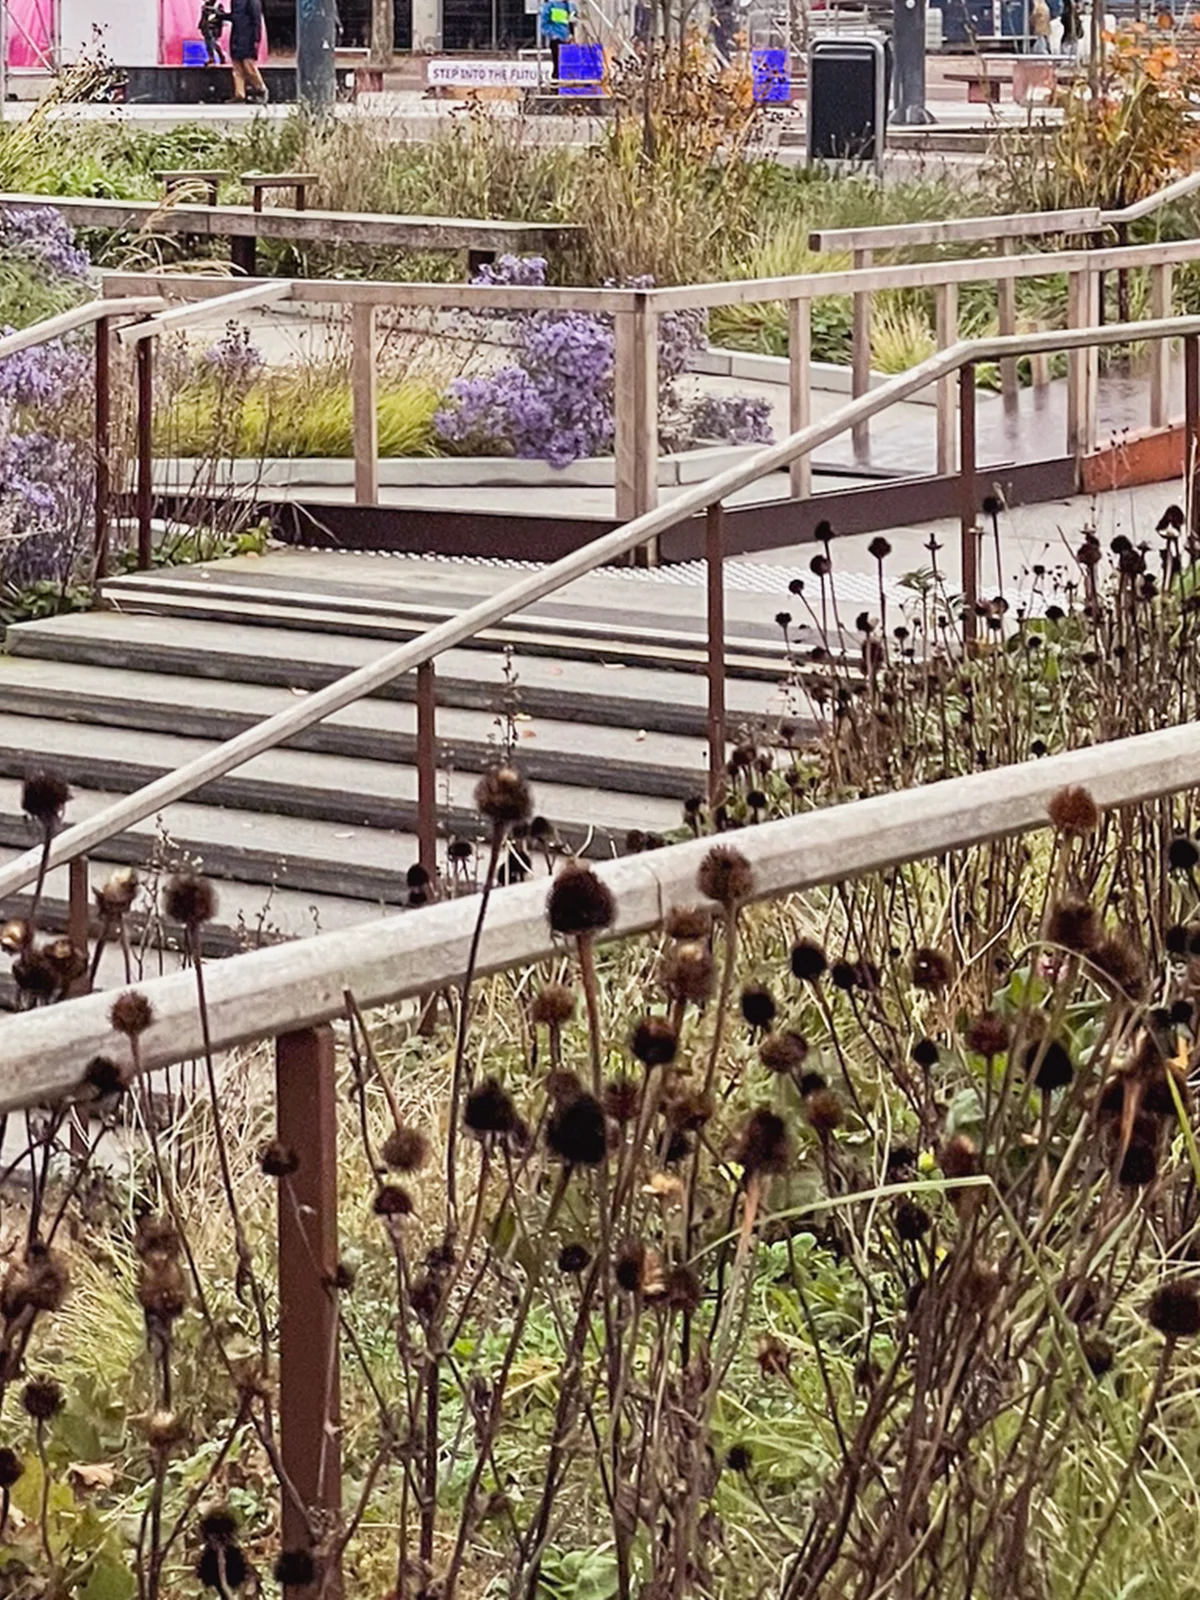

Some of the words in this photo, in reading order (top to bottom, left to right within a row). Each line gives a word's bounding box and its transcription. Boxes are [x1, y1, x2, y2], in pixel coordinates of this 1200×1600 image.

[433, 68, 459, 80] STEP
[460, 68, 486, 80] INTO
[488, 68, 507, 81] THE
